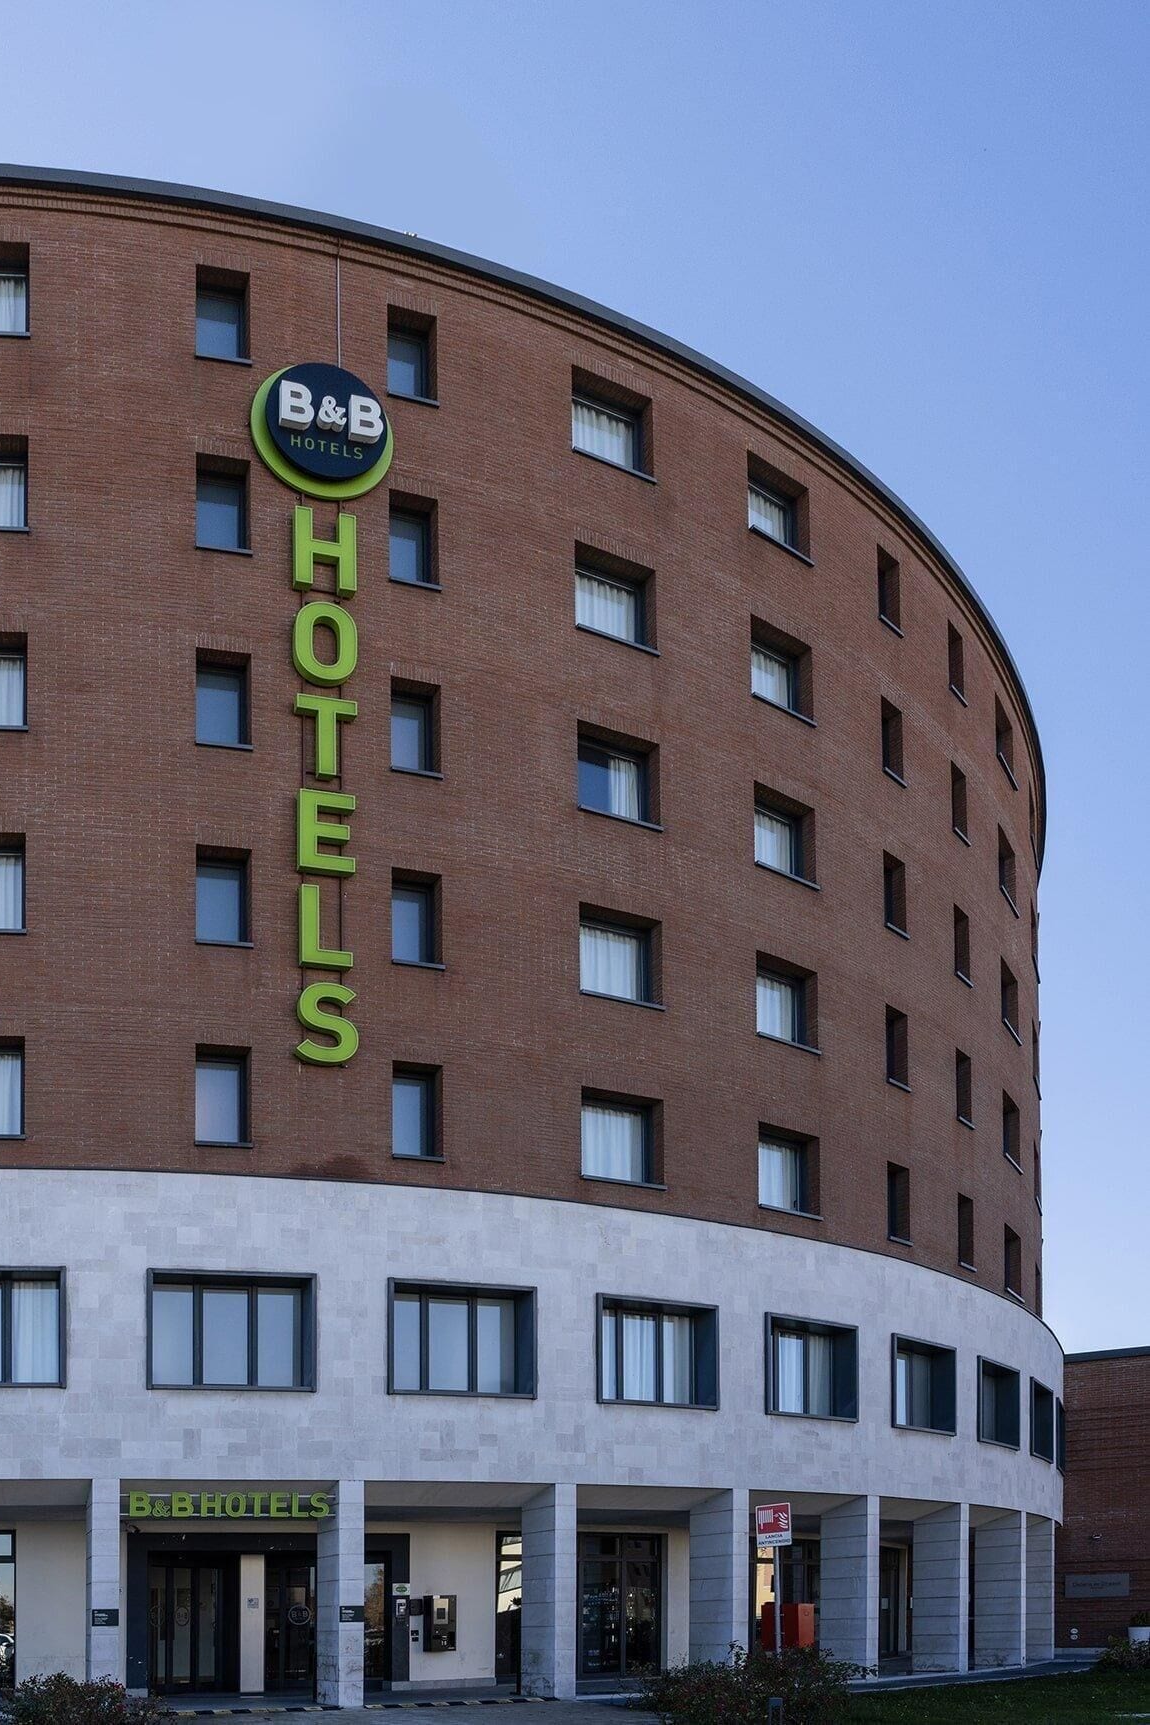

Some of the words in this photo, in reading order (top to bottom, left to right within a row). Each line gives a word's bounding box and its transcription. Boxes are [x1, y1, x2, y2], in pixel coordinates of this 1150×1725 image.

[279, 380, 383, 444] B&B
[290, 434, 364, 460] HOTELS
[293, 505, 359, 1066] HOTELS
[129, 1491, 194, 1517] B&B
[200, 1491, 330, 1518] HOTELS
